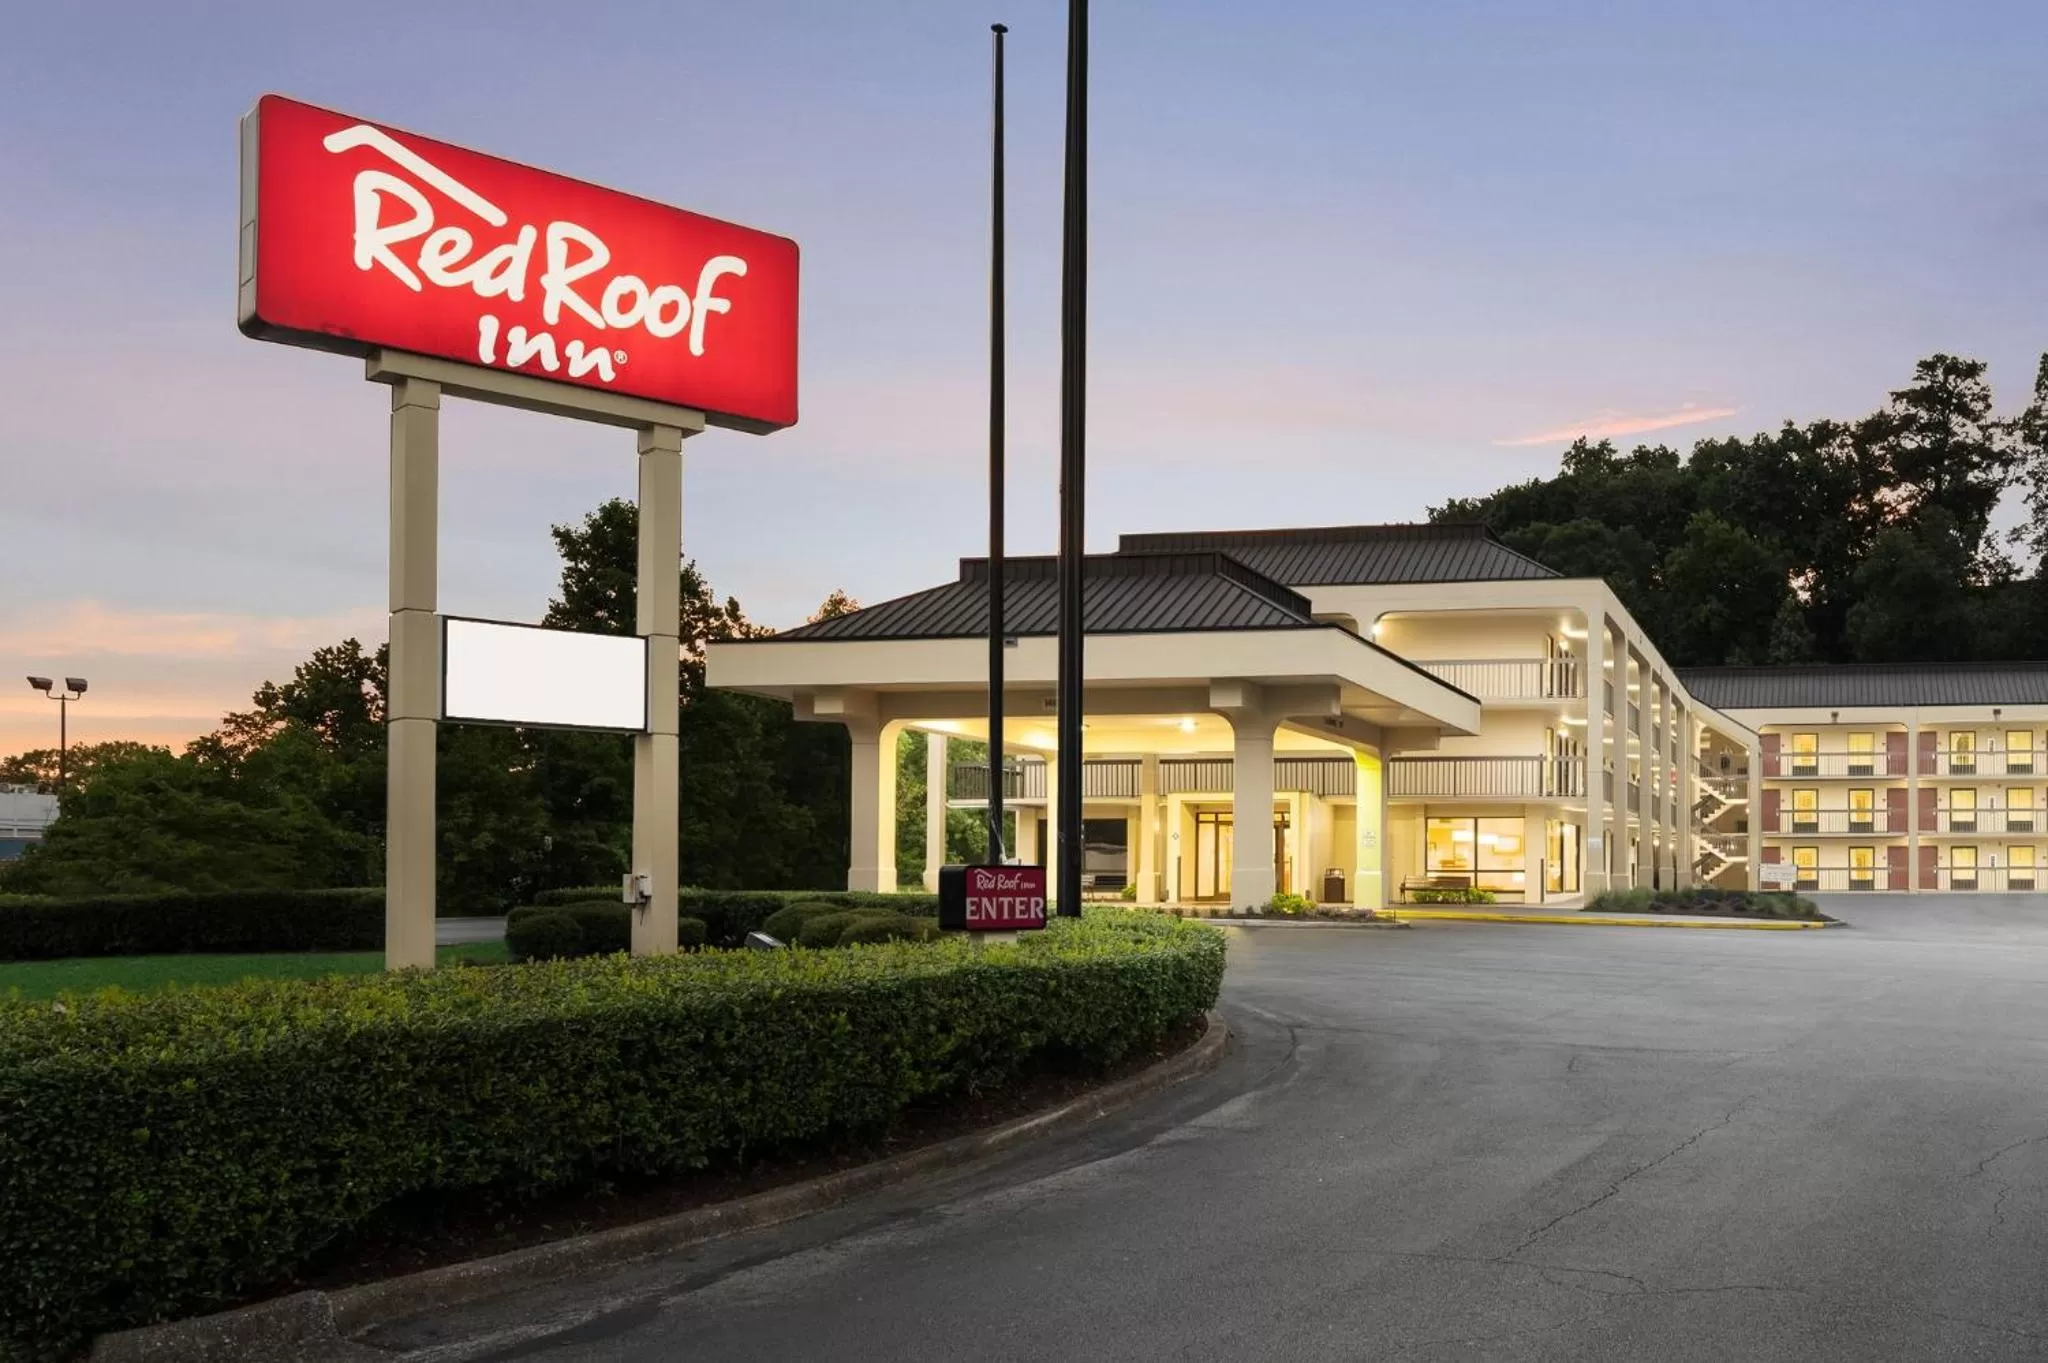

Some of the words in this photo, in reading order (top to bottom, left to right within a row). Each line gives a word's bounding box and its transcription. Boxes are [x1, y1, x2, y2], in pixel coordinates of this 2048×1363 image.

[976, 874, 996, 890] Red
[997, 872, 1022, 890] Roof
[966, 896, 1044, 919] ENTER
